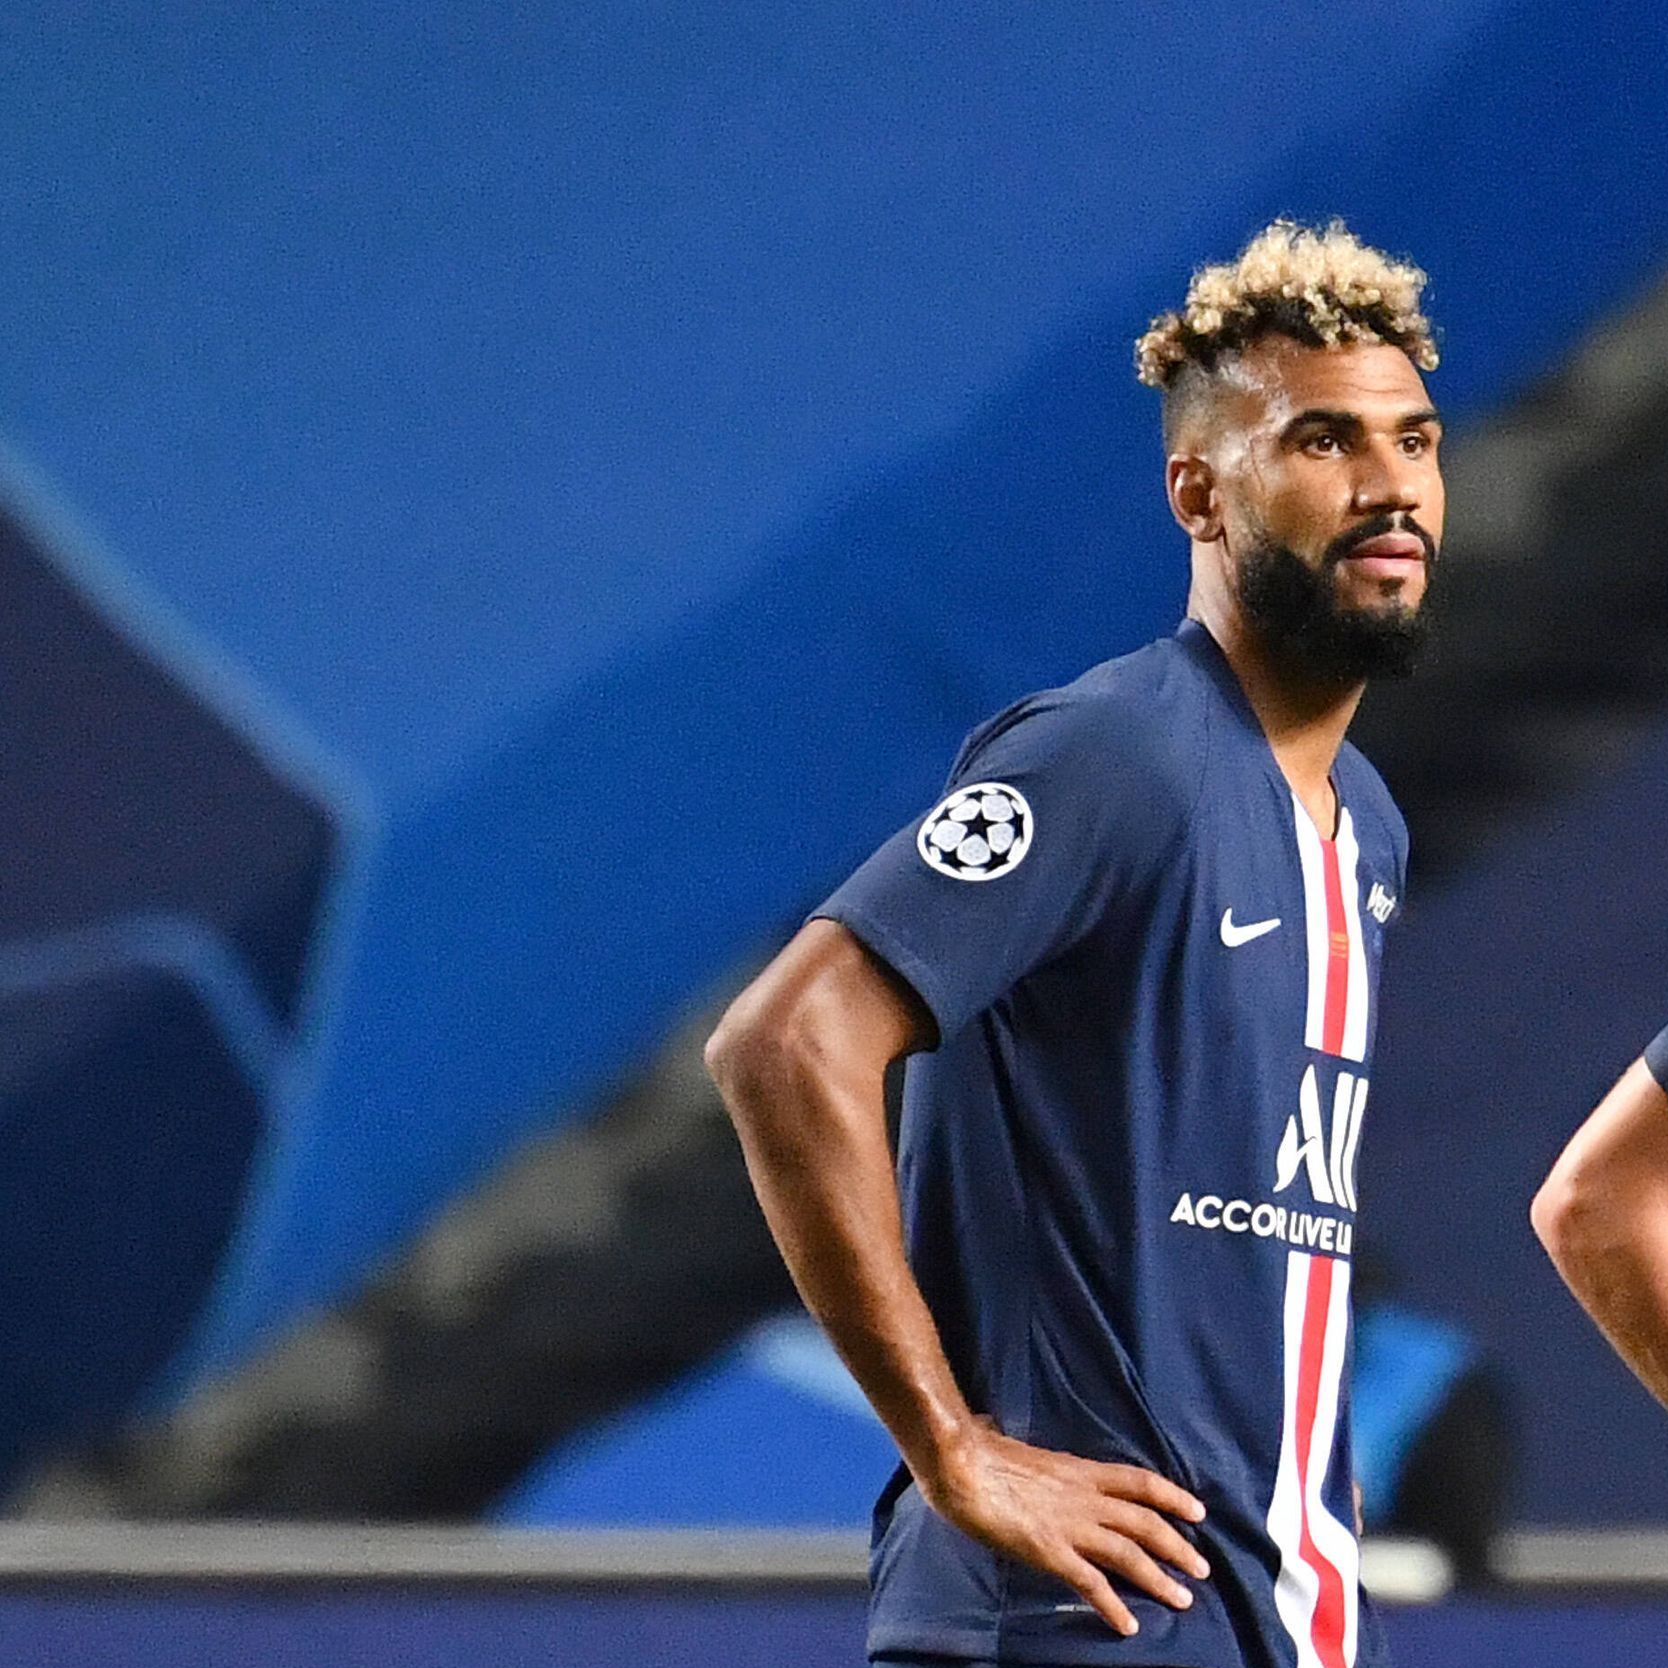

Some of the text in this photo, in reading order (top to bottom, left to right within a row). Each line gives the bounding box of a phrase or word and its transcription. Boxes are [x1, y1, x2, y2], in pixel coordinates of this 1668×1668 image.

[1169, 1192, 1353, 1255] ACCOR LIVE LI
